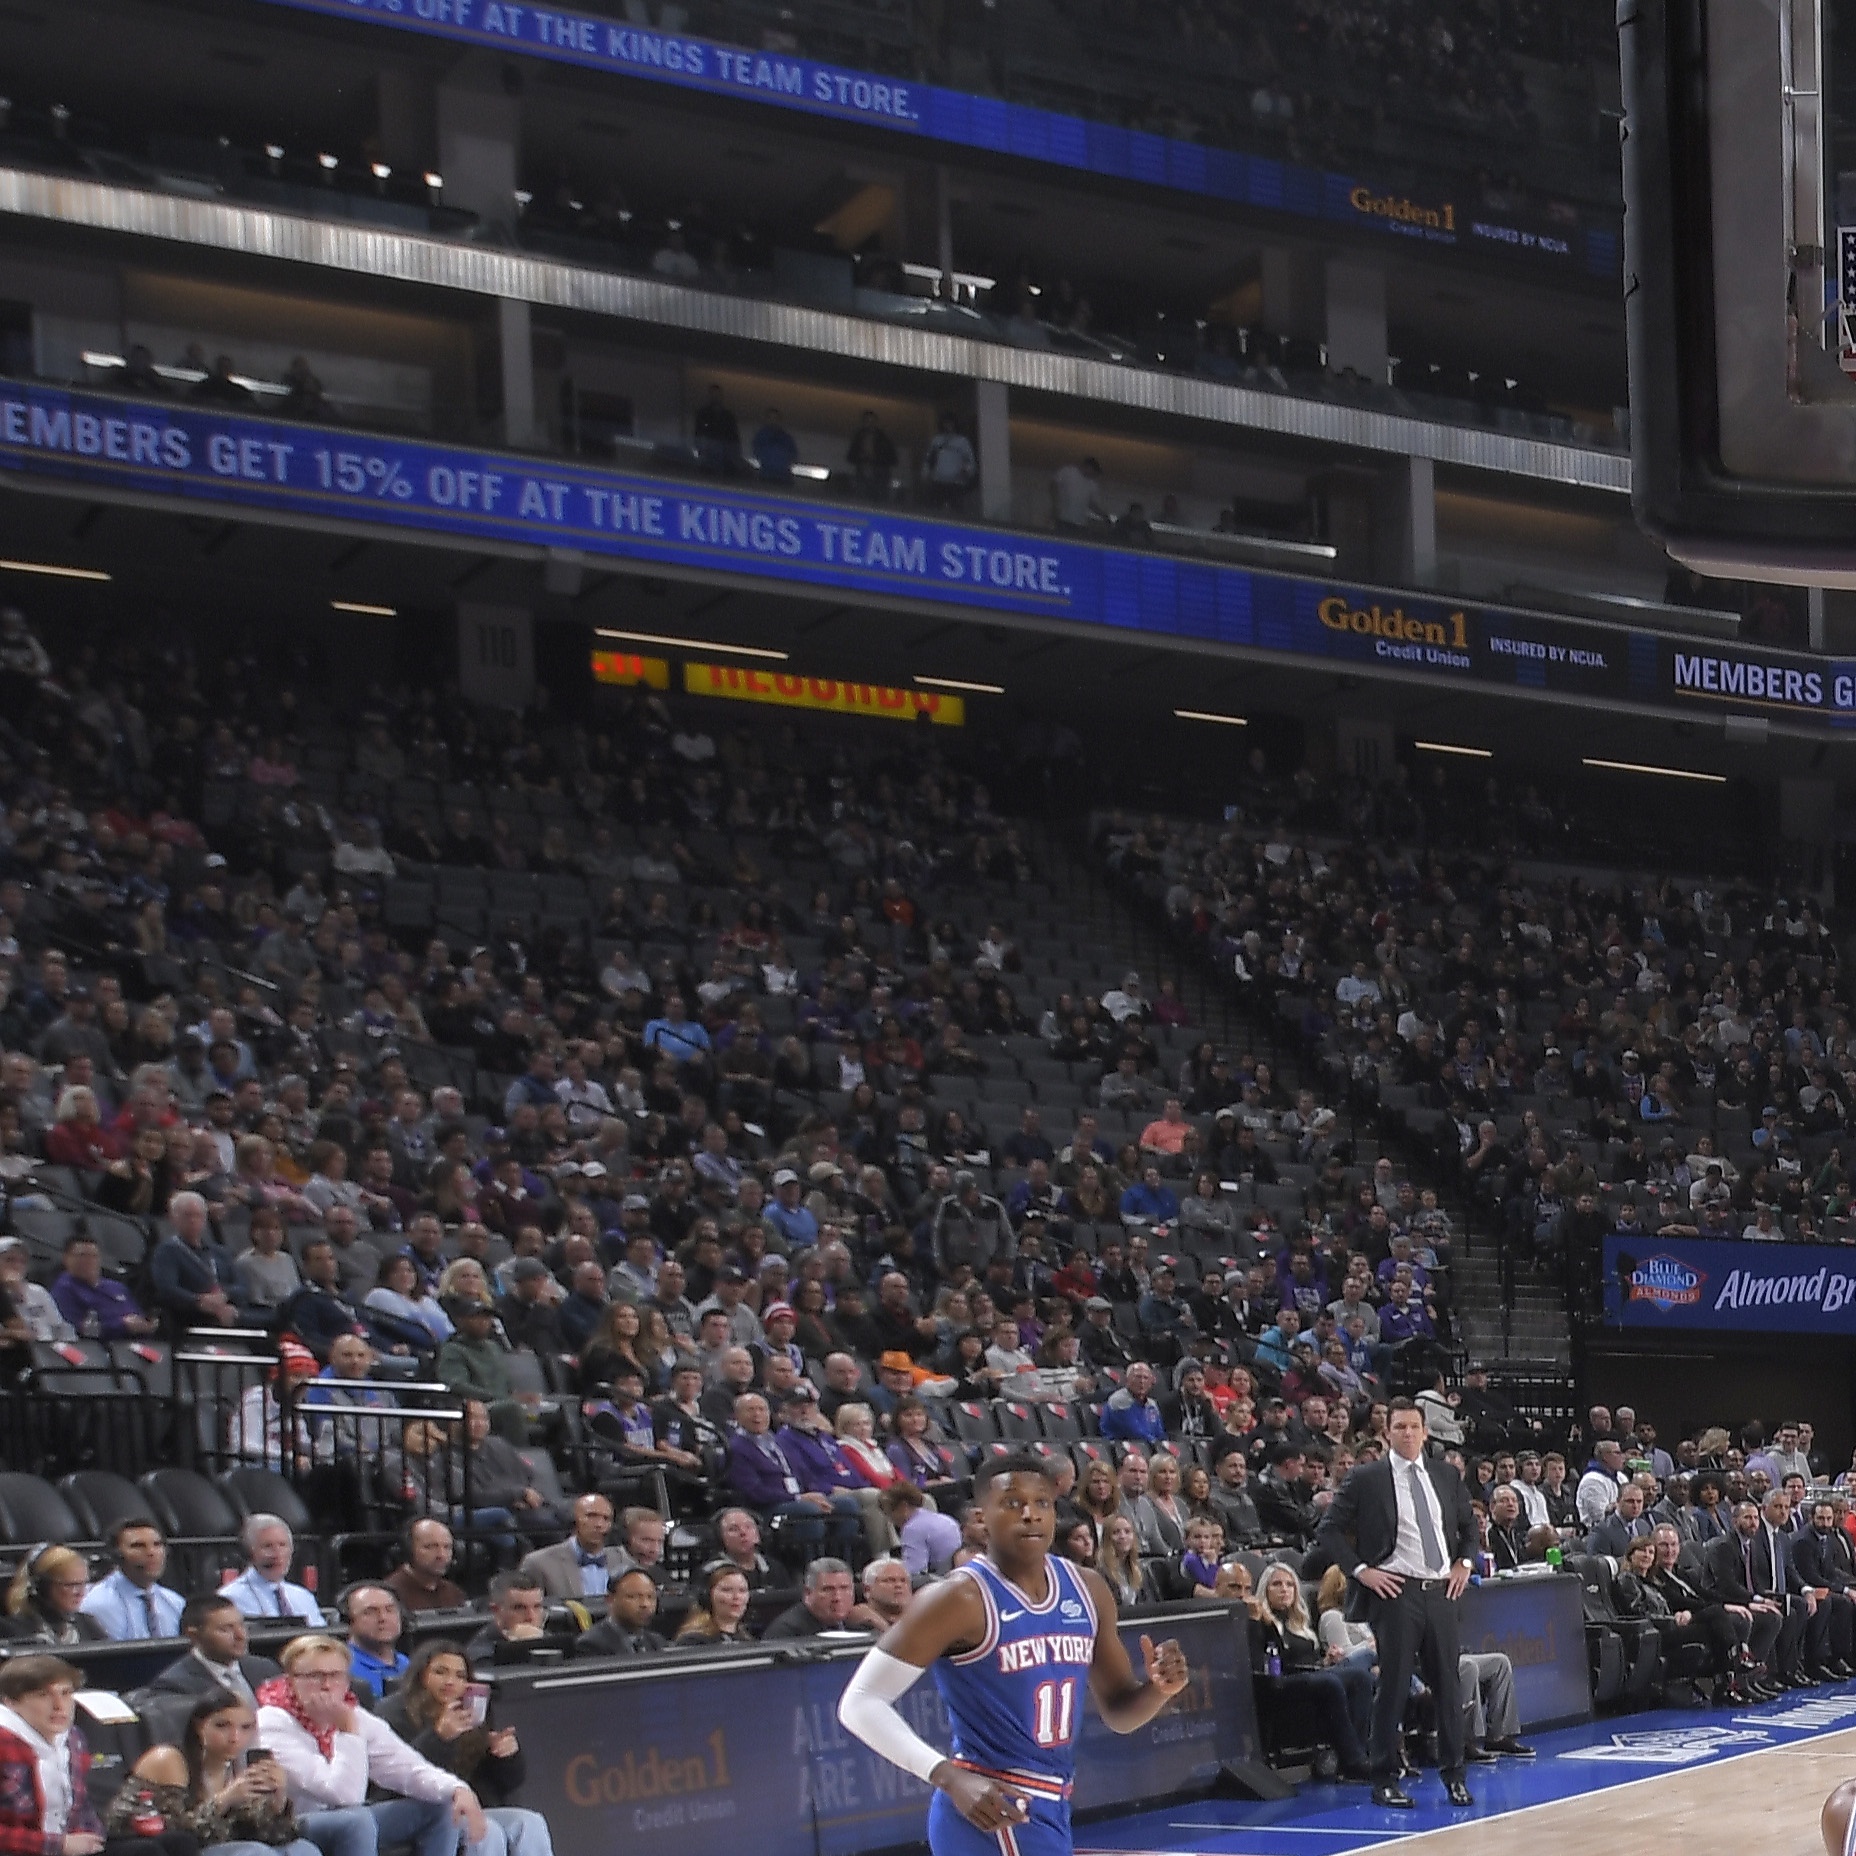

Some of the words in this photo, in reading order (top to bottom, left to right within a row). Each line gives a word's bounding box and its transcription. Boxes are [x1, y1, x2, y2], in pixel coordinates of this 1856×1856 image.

[482, 3, 523, 37] AT
[535, 11, 597, 52] THE
[608, 29, 703, 74] KINGS
[716, 50, 802, 94] TEAM
[813, 71, 919, 119] STORE.
[1350, 186, 1439, 228] Golden
[0, 401, 192, 470] EMBERS
[208, 435, 293, 483] GET
[314, 449, 413, 499] 15%
[428, 465, 502, 511] OFF
[519, 480, 570, 523] AT
[585, 488, 665, 537] THE
[680, 503, 801, 557] KINGS
[815, 522, 927, 574] TEAM
[941, 542, 1072, 596] STORE.
[1317, 596, 1446, 646] Golden
[1448, 610, 1468, 649] 1
[1374, 640, 1423, 662] Credit
[1426, 647, 1471, 669] Union
[1488, 636, 1547, 659] INSURED
[1549, 646, 1567, 662] BY
[1673, 652, 1823, 704] MEMBERS
[1631, 1269, 1698, 1288] DIAMOND
[1649, 1259, 1681, 1275] BLUE
[998, 1636, 1047, 1673] NEW
[1033, 1678, 1076, 1749] 11
[565, 1744, 709, 1807] Golden
